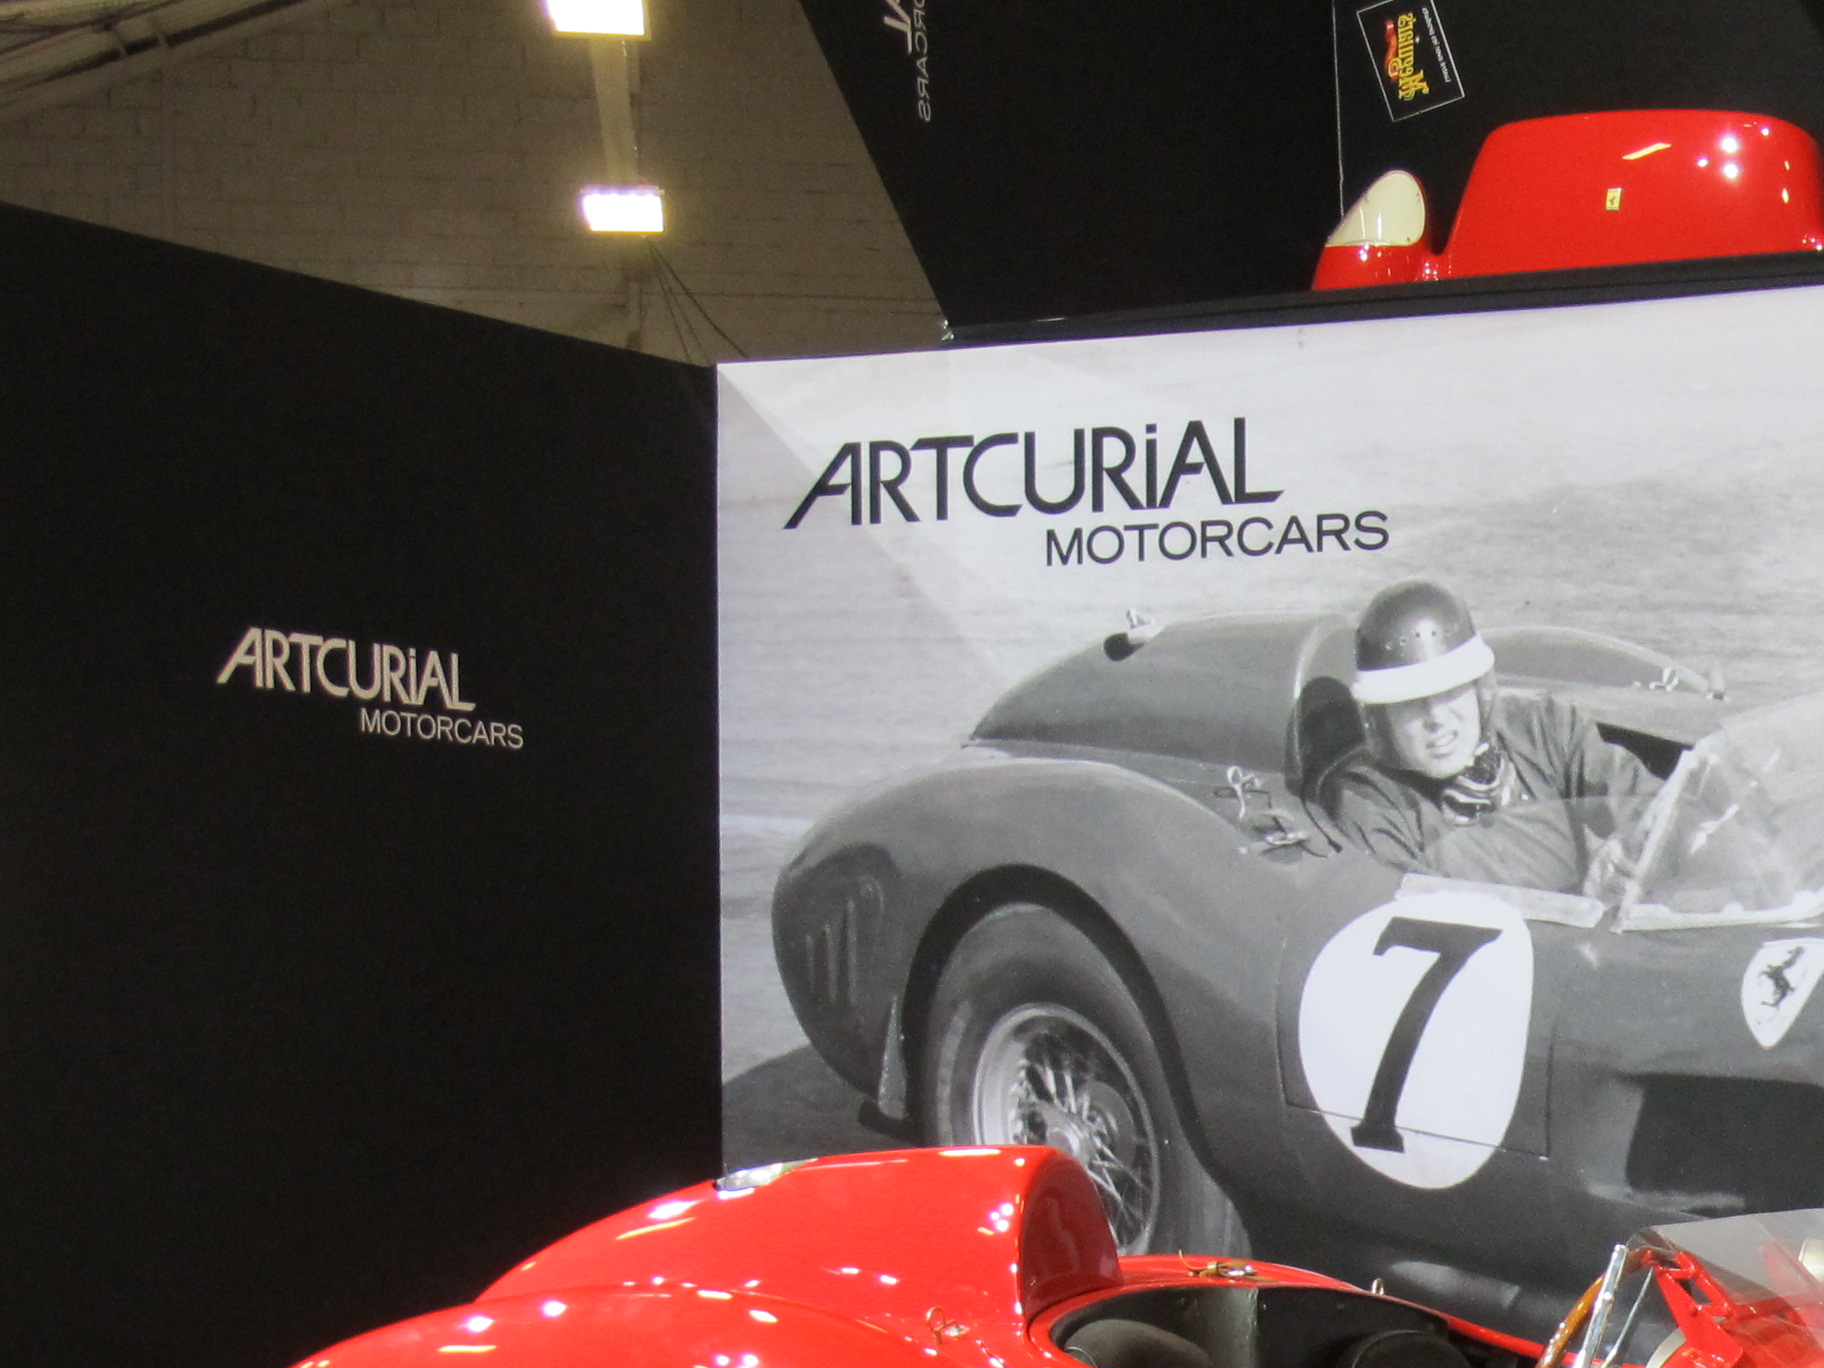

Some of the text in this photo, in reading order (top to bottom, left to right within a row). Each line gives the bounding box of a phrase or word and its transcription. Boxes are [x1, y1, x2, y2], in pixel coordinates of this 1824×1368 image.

[1046, 510, 1390, 567] MOTORCARS
[360, 707, 525, 750] MOTORCARS
[1350, 916, 1504, 1154] 7
